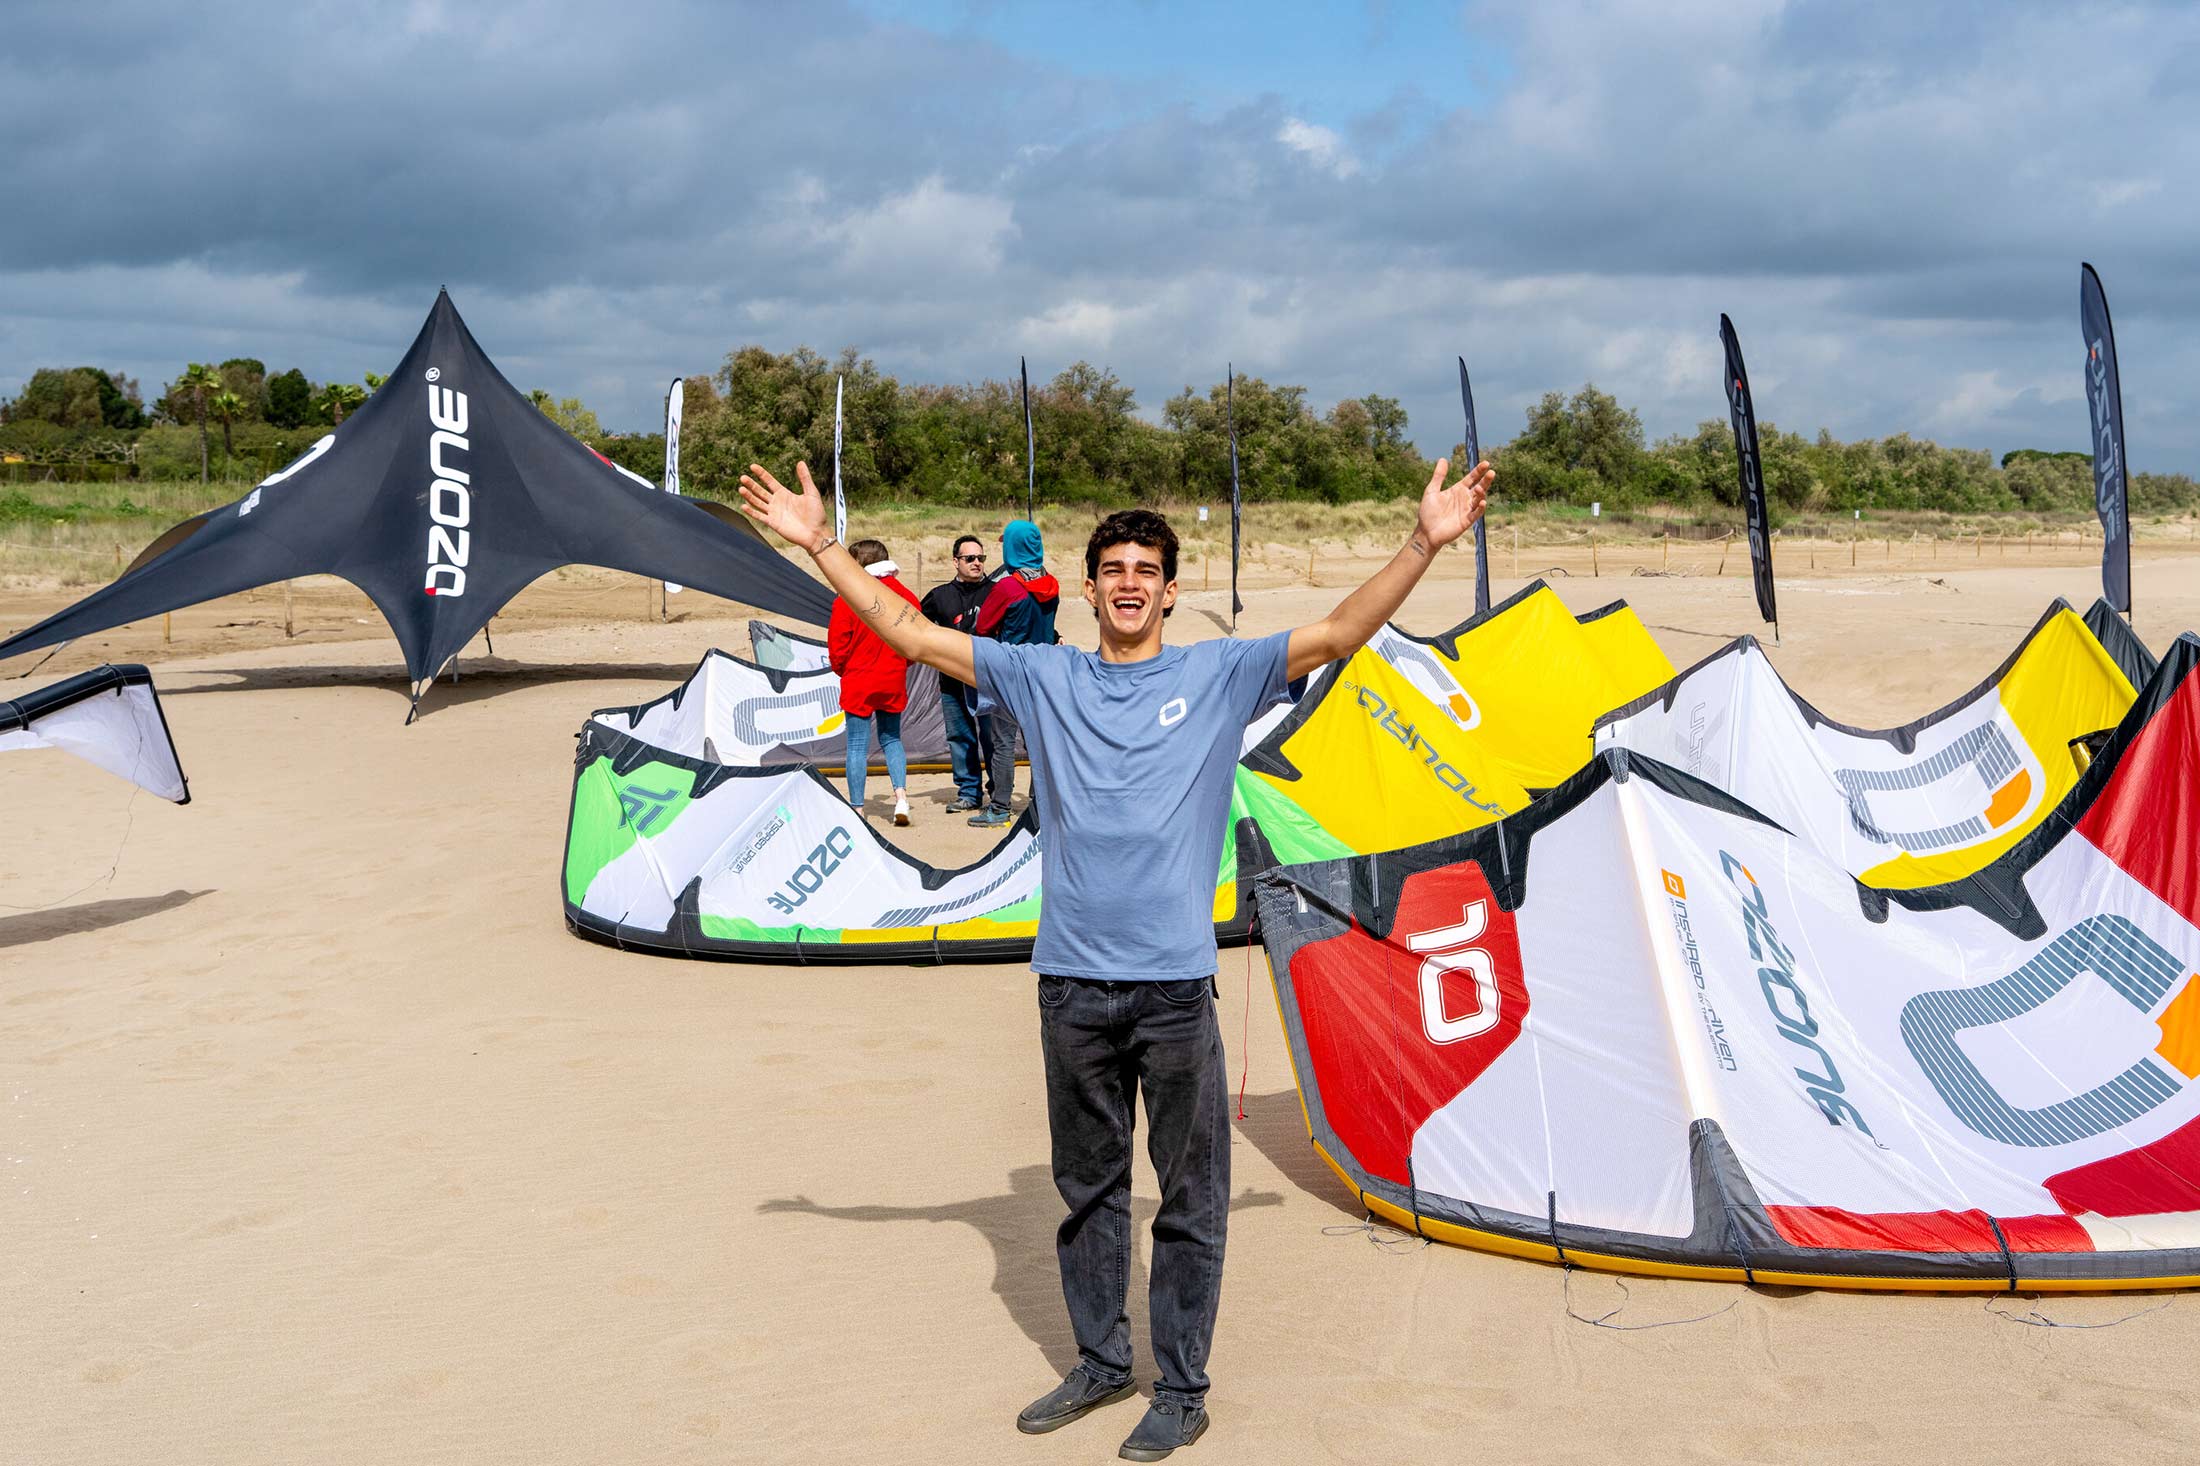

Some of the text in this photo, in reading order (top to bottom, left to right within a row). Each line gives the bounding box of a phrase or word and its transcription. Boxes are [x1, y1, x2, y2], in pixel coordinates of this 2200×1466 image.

[767, 825, 856, 915] OZONE
[1406, 898, 1501, 1046] 10
[1718, 849, 1876, 1139] OZONE
[1704, 993, 1737, 1072] RIVEN
